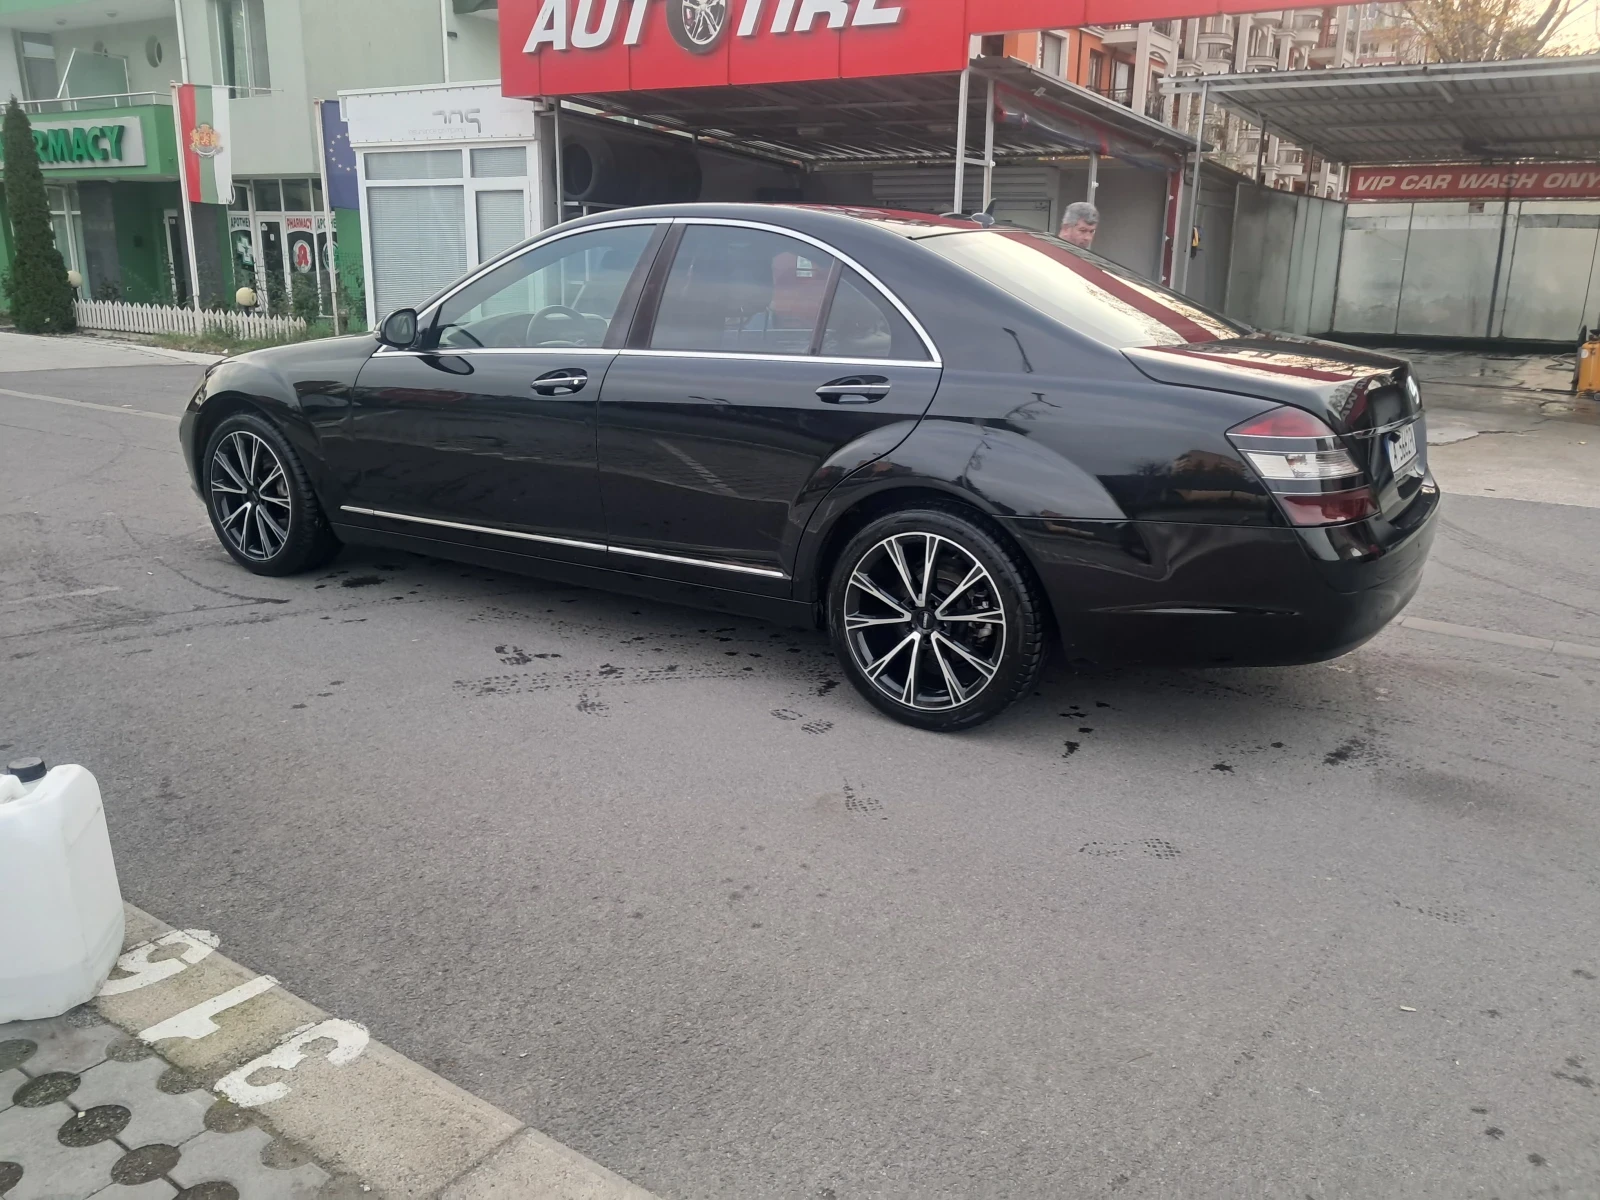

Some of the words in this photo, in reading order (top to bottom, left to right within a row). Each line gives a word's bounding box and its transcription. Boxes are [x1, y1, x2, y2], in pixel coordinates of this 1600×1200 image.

[31, 125, 123, 163] RMACY
[1357, 175, 1396, 191] VIP
[1400, 174, 1452, 190] CAR
[1458, 173, 1538, 189] WASH
[1543, 172, 1600, 188] ONY
[286, 217, 313, 230] PHARMACY
